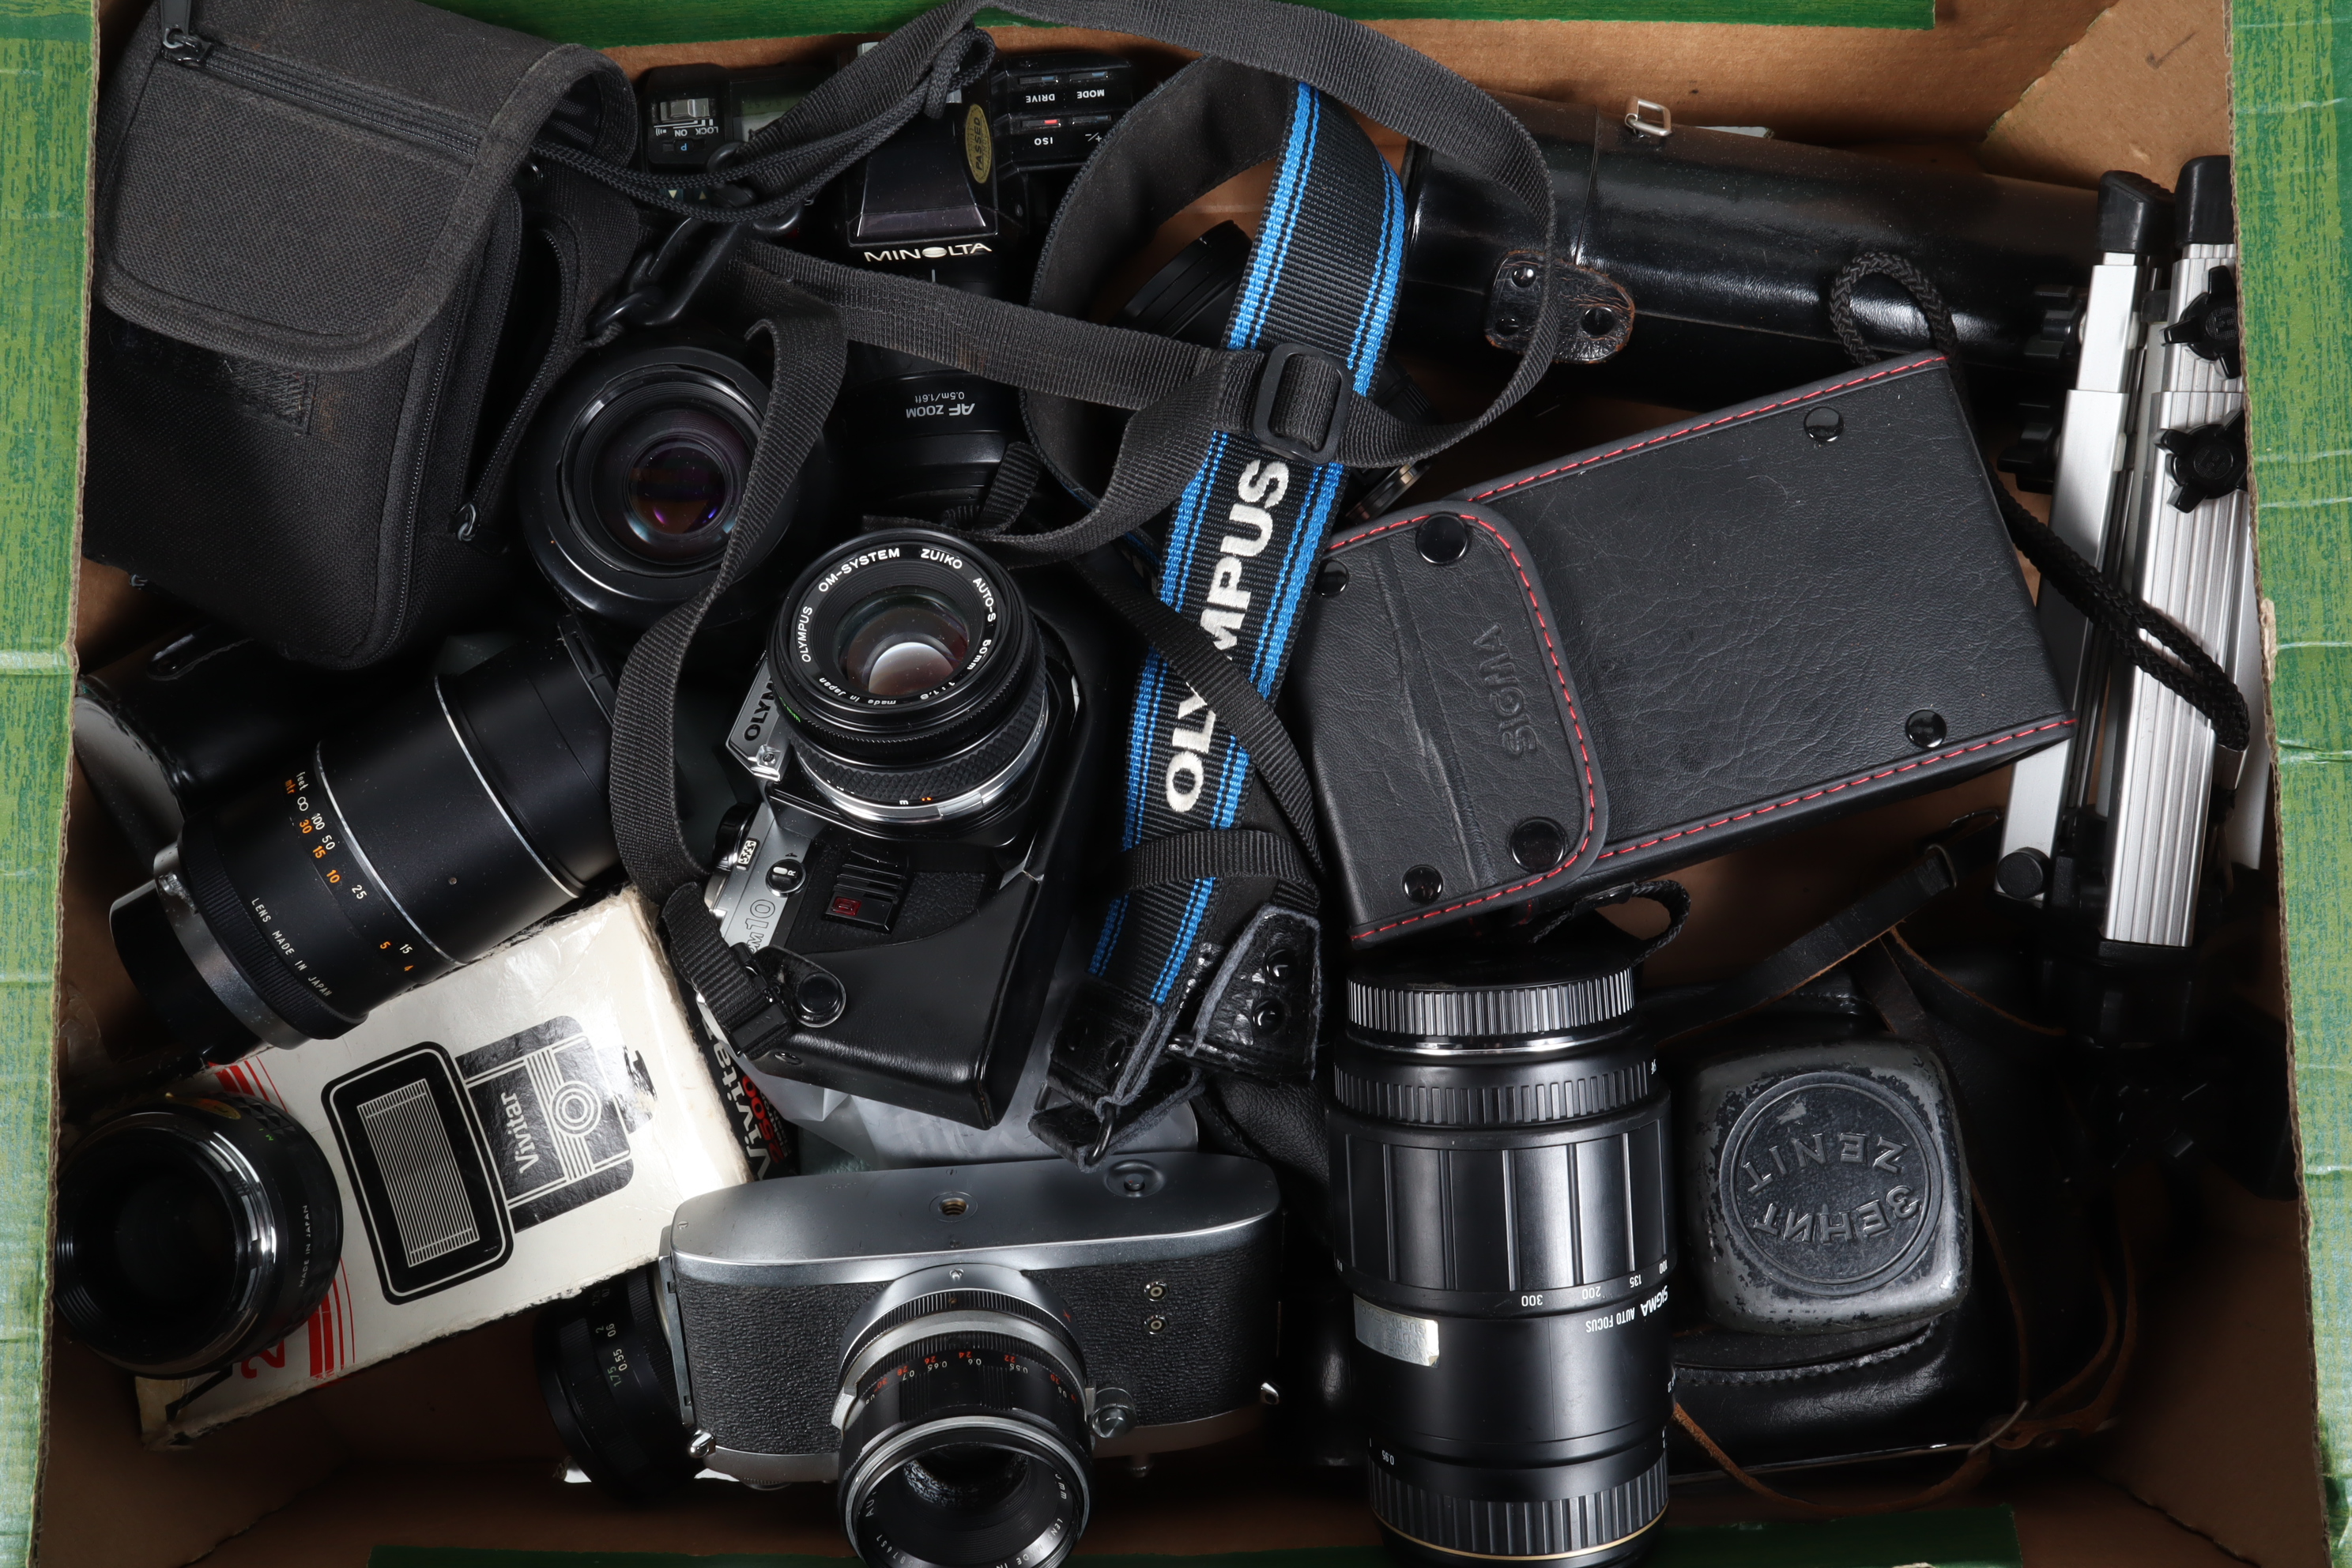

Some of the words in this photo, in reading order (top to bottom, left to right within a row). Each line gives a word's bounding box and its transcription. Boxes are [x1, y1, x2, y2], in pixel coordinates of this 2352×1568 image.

[1026, 93, 1056, 104] DRIVE
[1076, 89, 1105, 99] MODE
[674, 129, 688, 138] ON
[695, 126, 718, 136] LOCK
[1034, 137, 1054, 146] ISO
[864, 243, 993, 262] MINOLTA
[914, 391, 965, 403] 0.5m/1.6ft
[906, 405, 944, 418] ZOOM
[948, 403, 975, 416] AF
[818, 548, 900, 592] OM-SYSTEM
[921, 548, 963, 569] ZUIKO
[973, 577, 997, 622] AUTO-S
[797, 605, 813, 663] OLYMPUS
[967, 639, 992, 671] 50mm
[819, 677, 846, 697] Japan
[1472, 622, 1537, 756] SIGMA
[296, 771, 309, 790] feet
[311, 812, 326, 831] 100
[322, 835, 335, 850] 50
[352, 884, 368, 899] 25
[400, 944, 413, 954] 15
[300, 819, 312, 834] 30
[313, 845, 326, 859] 15
[326, 869, 341, 884] 10
[379, 940, 390, 949] 5
[251, 897, 271, 922] LENS
[272, 930, 295, 956] MADE
[295, 959, 307, 971] IN
[308, 976, 333, 997] JAPAN
[742, 1076, 786, 1164] 2500
[501, 1092, 539, 1174] Vivitar
[1742, 1133, 1907, 1195] ZENIT
[302, 1205, 311, 1238] JAPAN
[1753, 1185, 1922, 1245] ЗЕНИТ
[305, 1242, 311, 1254] IN
[299, 1260, 309, 1288] MADE
[1521, 1295, 1544, 1307] 300
[1582, 1286, 1601, 1300] 200
[1630, 1274, 1642, 1288] 135
[1659, 1260, 1668, 1274] 100
[1641, 1285, 1668, 1317] SIGMA
[1585, 1314, 1614, 1333] FOCUS
[1616, 1307, 1635, 1325] AUTO
[595, 1325, 605, 1334] 2
[608, 1366, 622, 1387] 1.75
[612, 1348, 628, 1371] 0.55
[925, 1355, 936, 1364] 26
[1004, 1355, 1016, 1363] 22
[927, 1360, 947, 1372] 0.65
[1009, 1363, 1028, 1374] 0.55
[1381, 1449, 1394, 1465] 0.95
[1047, 1517, 1063, 1541] LENS
[1016, 1544, 1044, 1566] MADE
